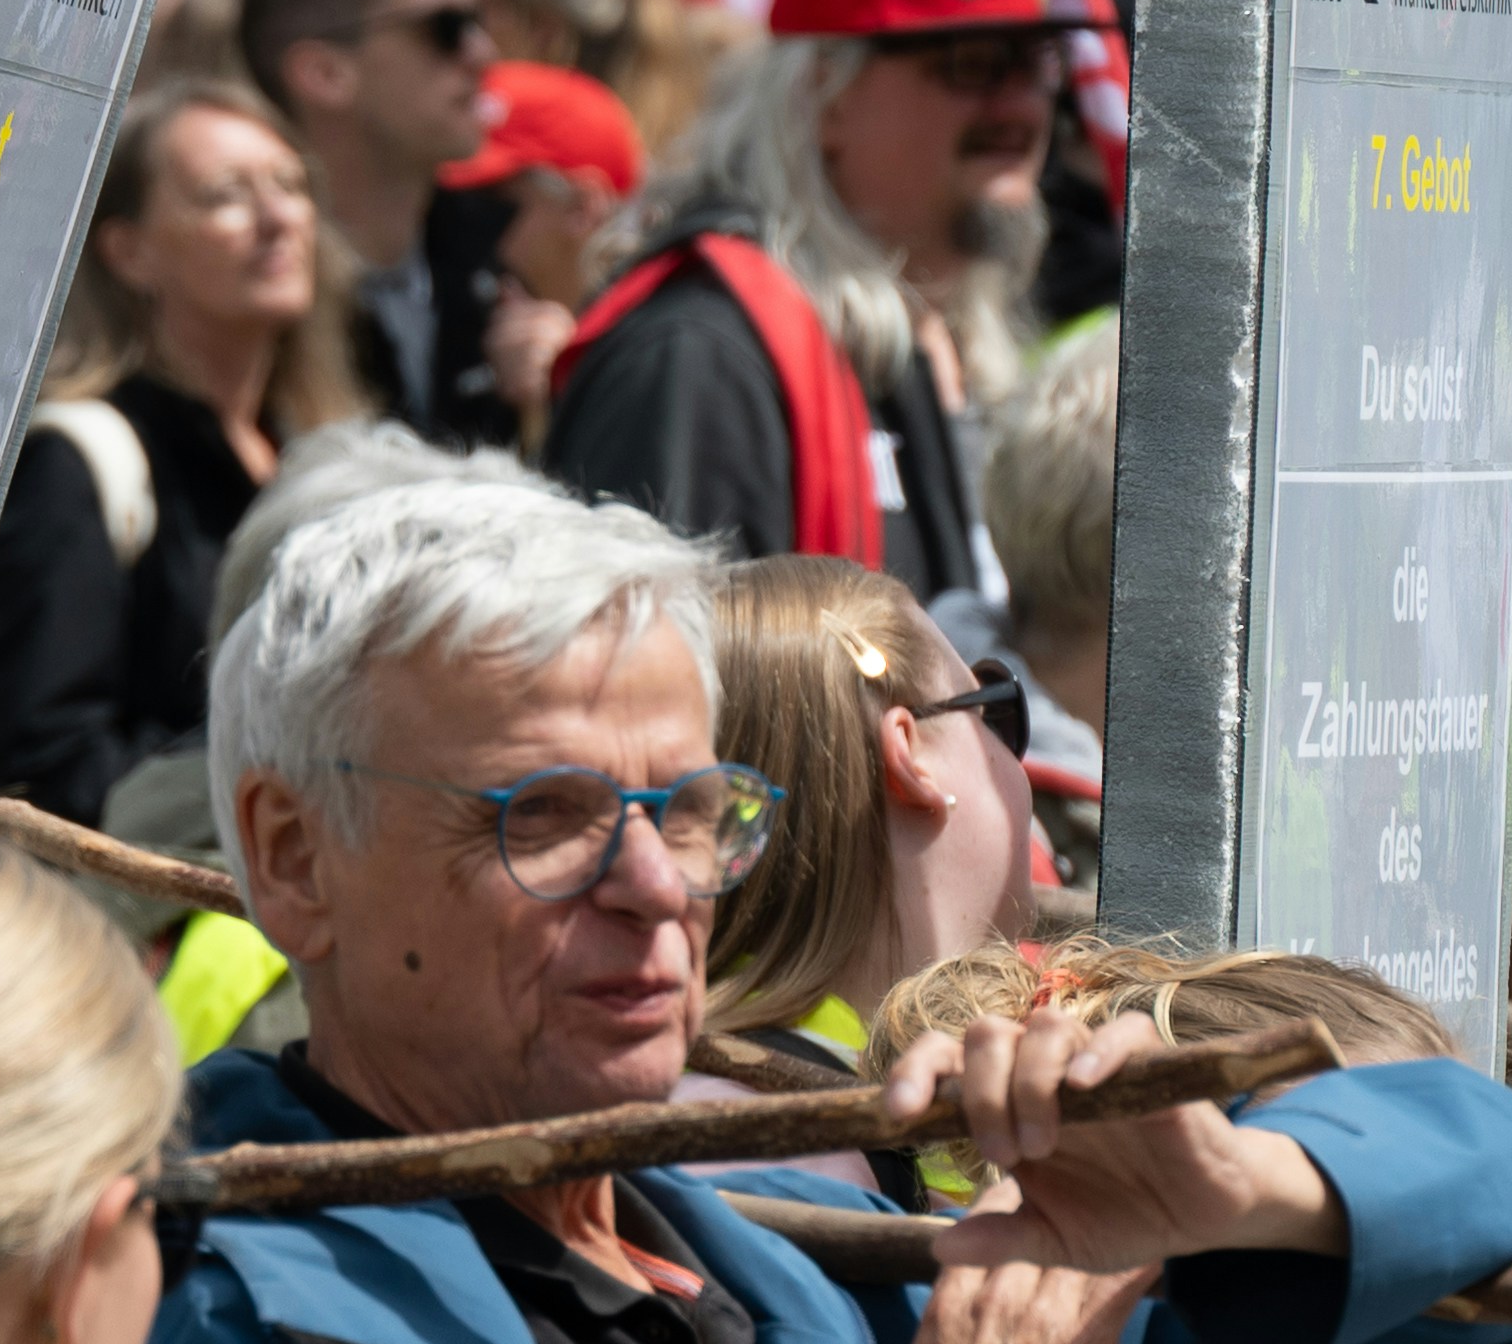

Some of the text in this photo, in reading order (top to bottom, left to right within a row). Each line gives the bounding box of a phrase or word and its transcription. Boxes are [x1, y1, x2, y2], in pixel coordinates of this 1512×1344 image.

[1371, 134, 1473, 214] 7. Gebot
[1359, 344, 1464, 424] Du sollst
[1393, 546, 1430, 624] die
[1298, 679, 1489, 775] Zahlungsdauer
[1378, 806, 1422, 883] des
